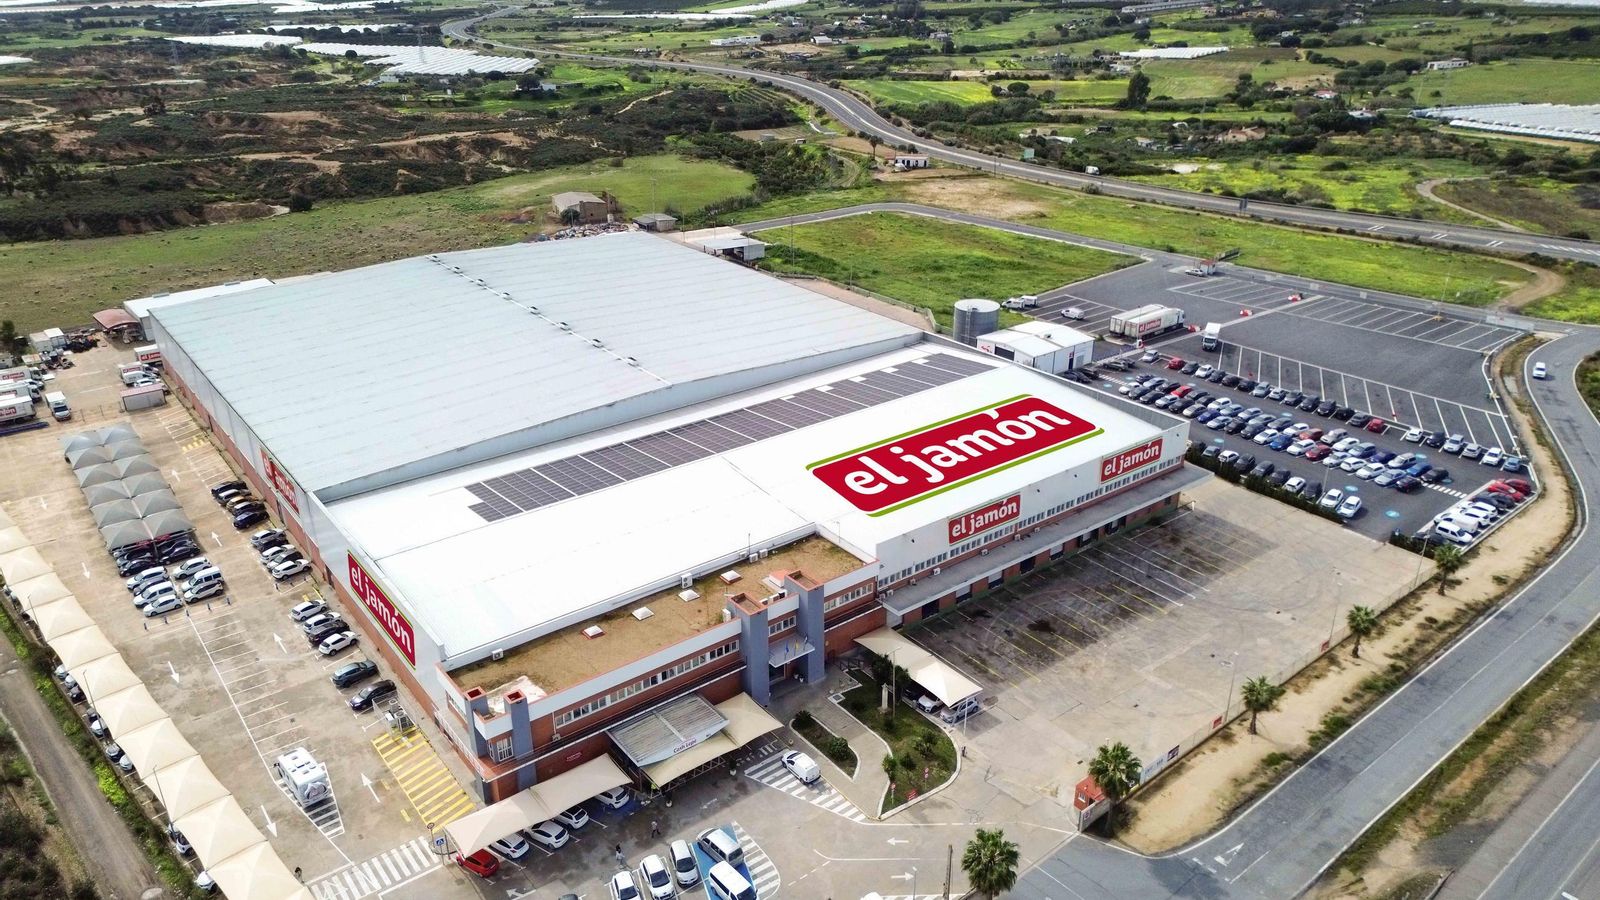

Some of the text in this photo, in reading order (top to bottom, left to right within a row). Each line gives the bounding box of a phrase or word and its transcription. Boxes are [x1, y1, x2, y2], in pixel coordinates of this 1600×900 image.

[844, 408, 1071, 495] el jamón
[1104, 441, 1159, 476] el jamón
[952, 499, 1018, 537] el jamón
[351, 566, 412, 654] el jamón
